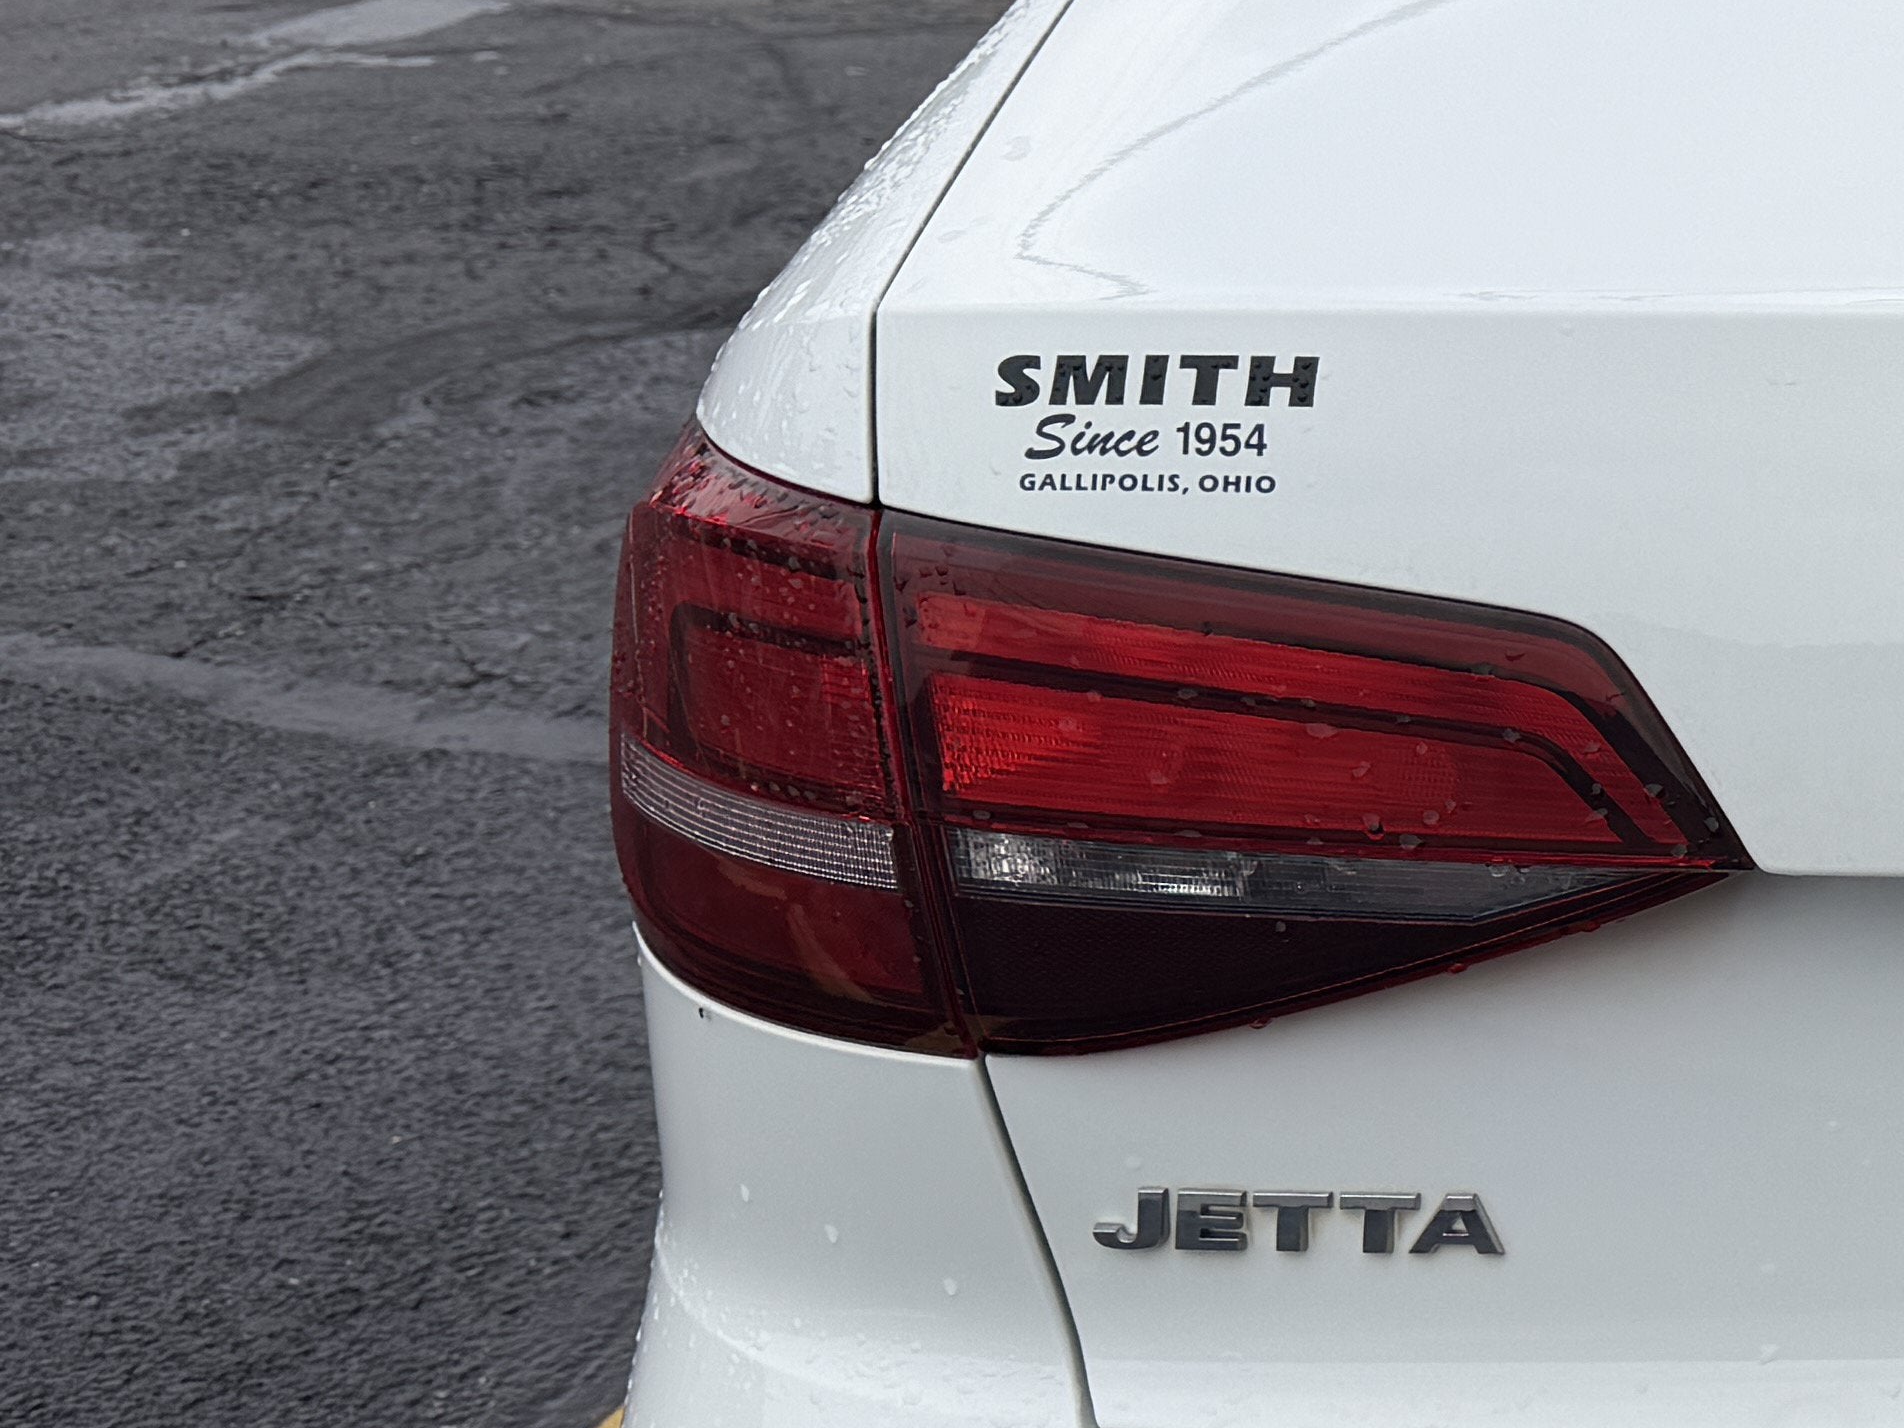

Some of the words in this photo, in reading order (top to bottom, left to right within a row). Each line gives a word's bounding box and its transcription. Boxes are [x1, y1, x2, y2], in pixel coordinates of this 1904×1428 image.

[995, 354, 1320, 407] SMITH
[1024, 413, 1160, 460] Since
[1176, 421, 1268, 457] 1954
[1018, 472, 1190, 496] GALLIPOLIS,
[1197, 474, 1277, 494] OHIO
[1092, 1186, 1506, 1255] JETTA
